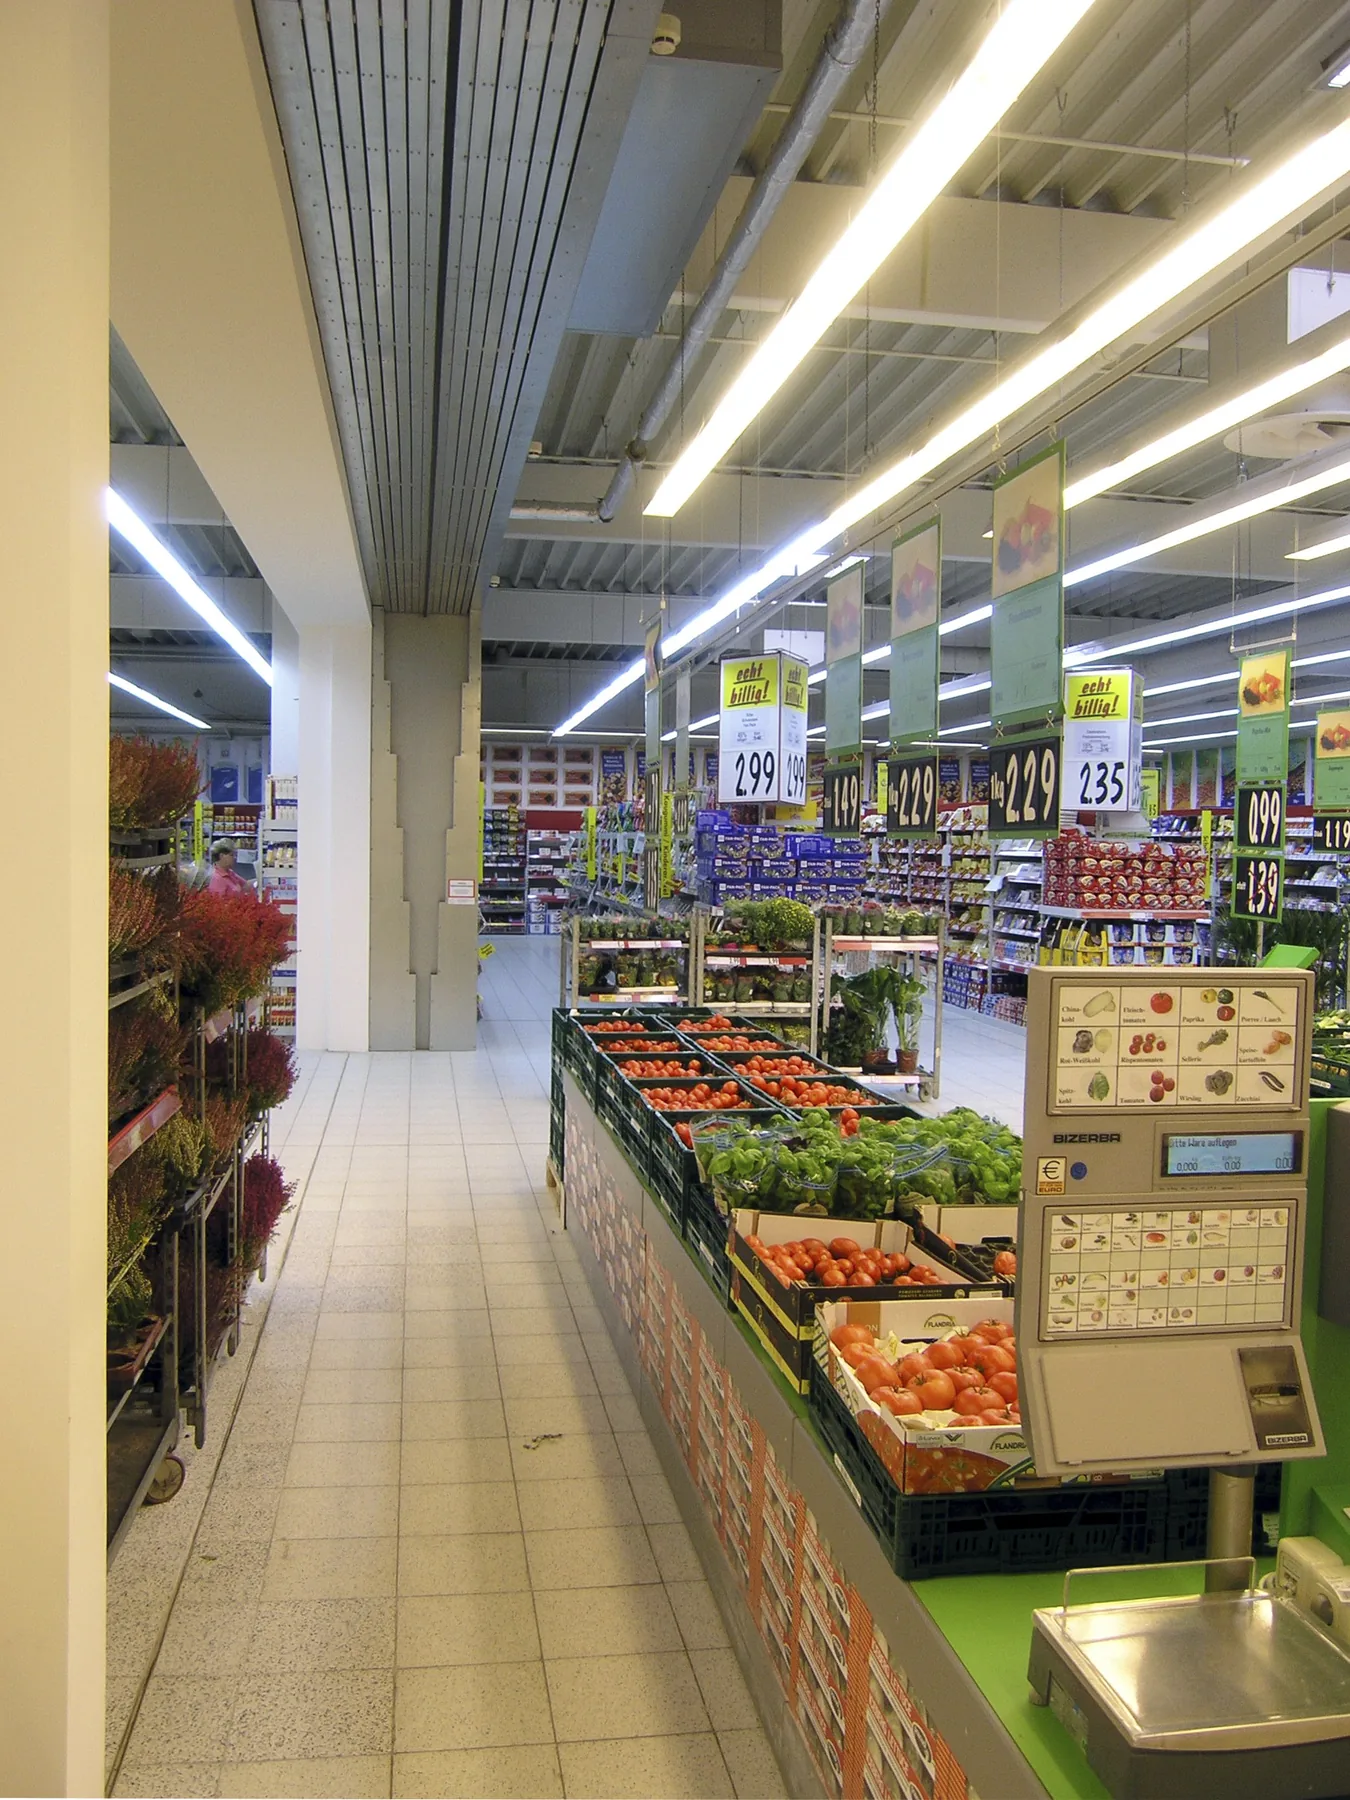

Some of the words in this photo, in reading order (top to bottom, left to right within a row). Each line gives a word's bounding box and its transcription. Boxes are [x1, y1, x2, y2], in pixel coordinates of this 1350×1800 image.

[736, 662, 763, 681] echt
[730, 680, 769, 705] billig!
[1081, 677, 1112, 694] echt
[1074, 695, 1119, 718] billig!
[735, 751, 775, 797] 2.99
[990, 771, 1005, 808] 1kg
[1005, 748, 1056, 823] 2.29
[1080, 761, 1125, 805] 2.35
[834, 775, 858, 826] 1.49
[899, 765, 933, 825] 2.29
[1249, 790, 1281, 844] 0.99
[1053, 1133, 1121, 1144] BIZERBA
[1188, 1138, 1206, 1148] Ware
[1207, 1138, 1237, 1149] auflegen
[1267, 1435, 1307, 1444] BIZERBA
